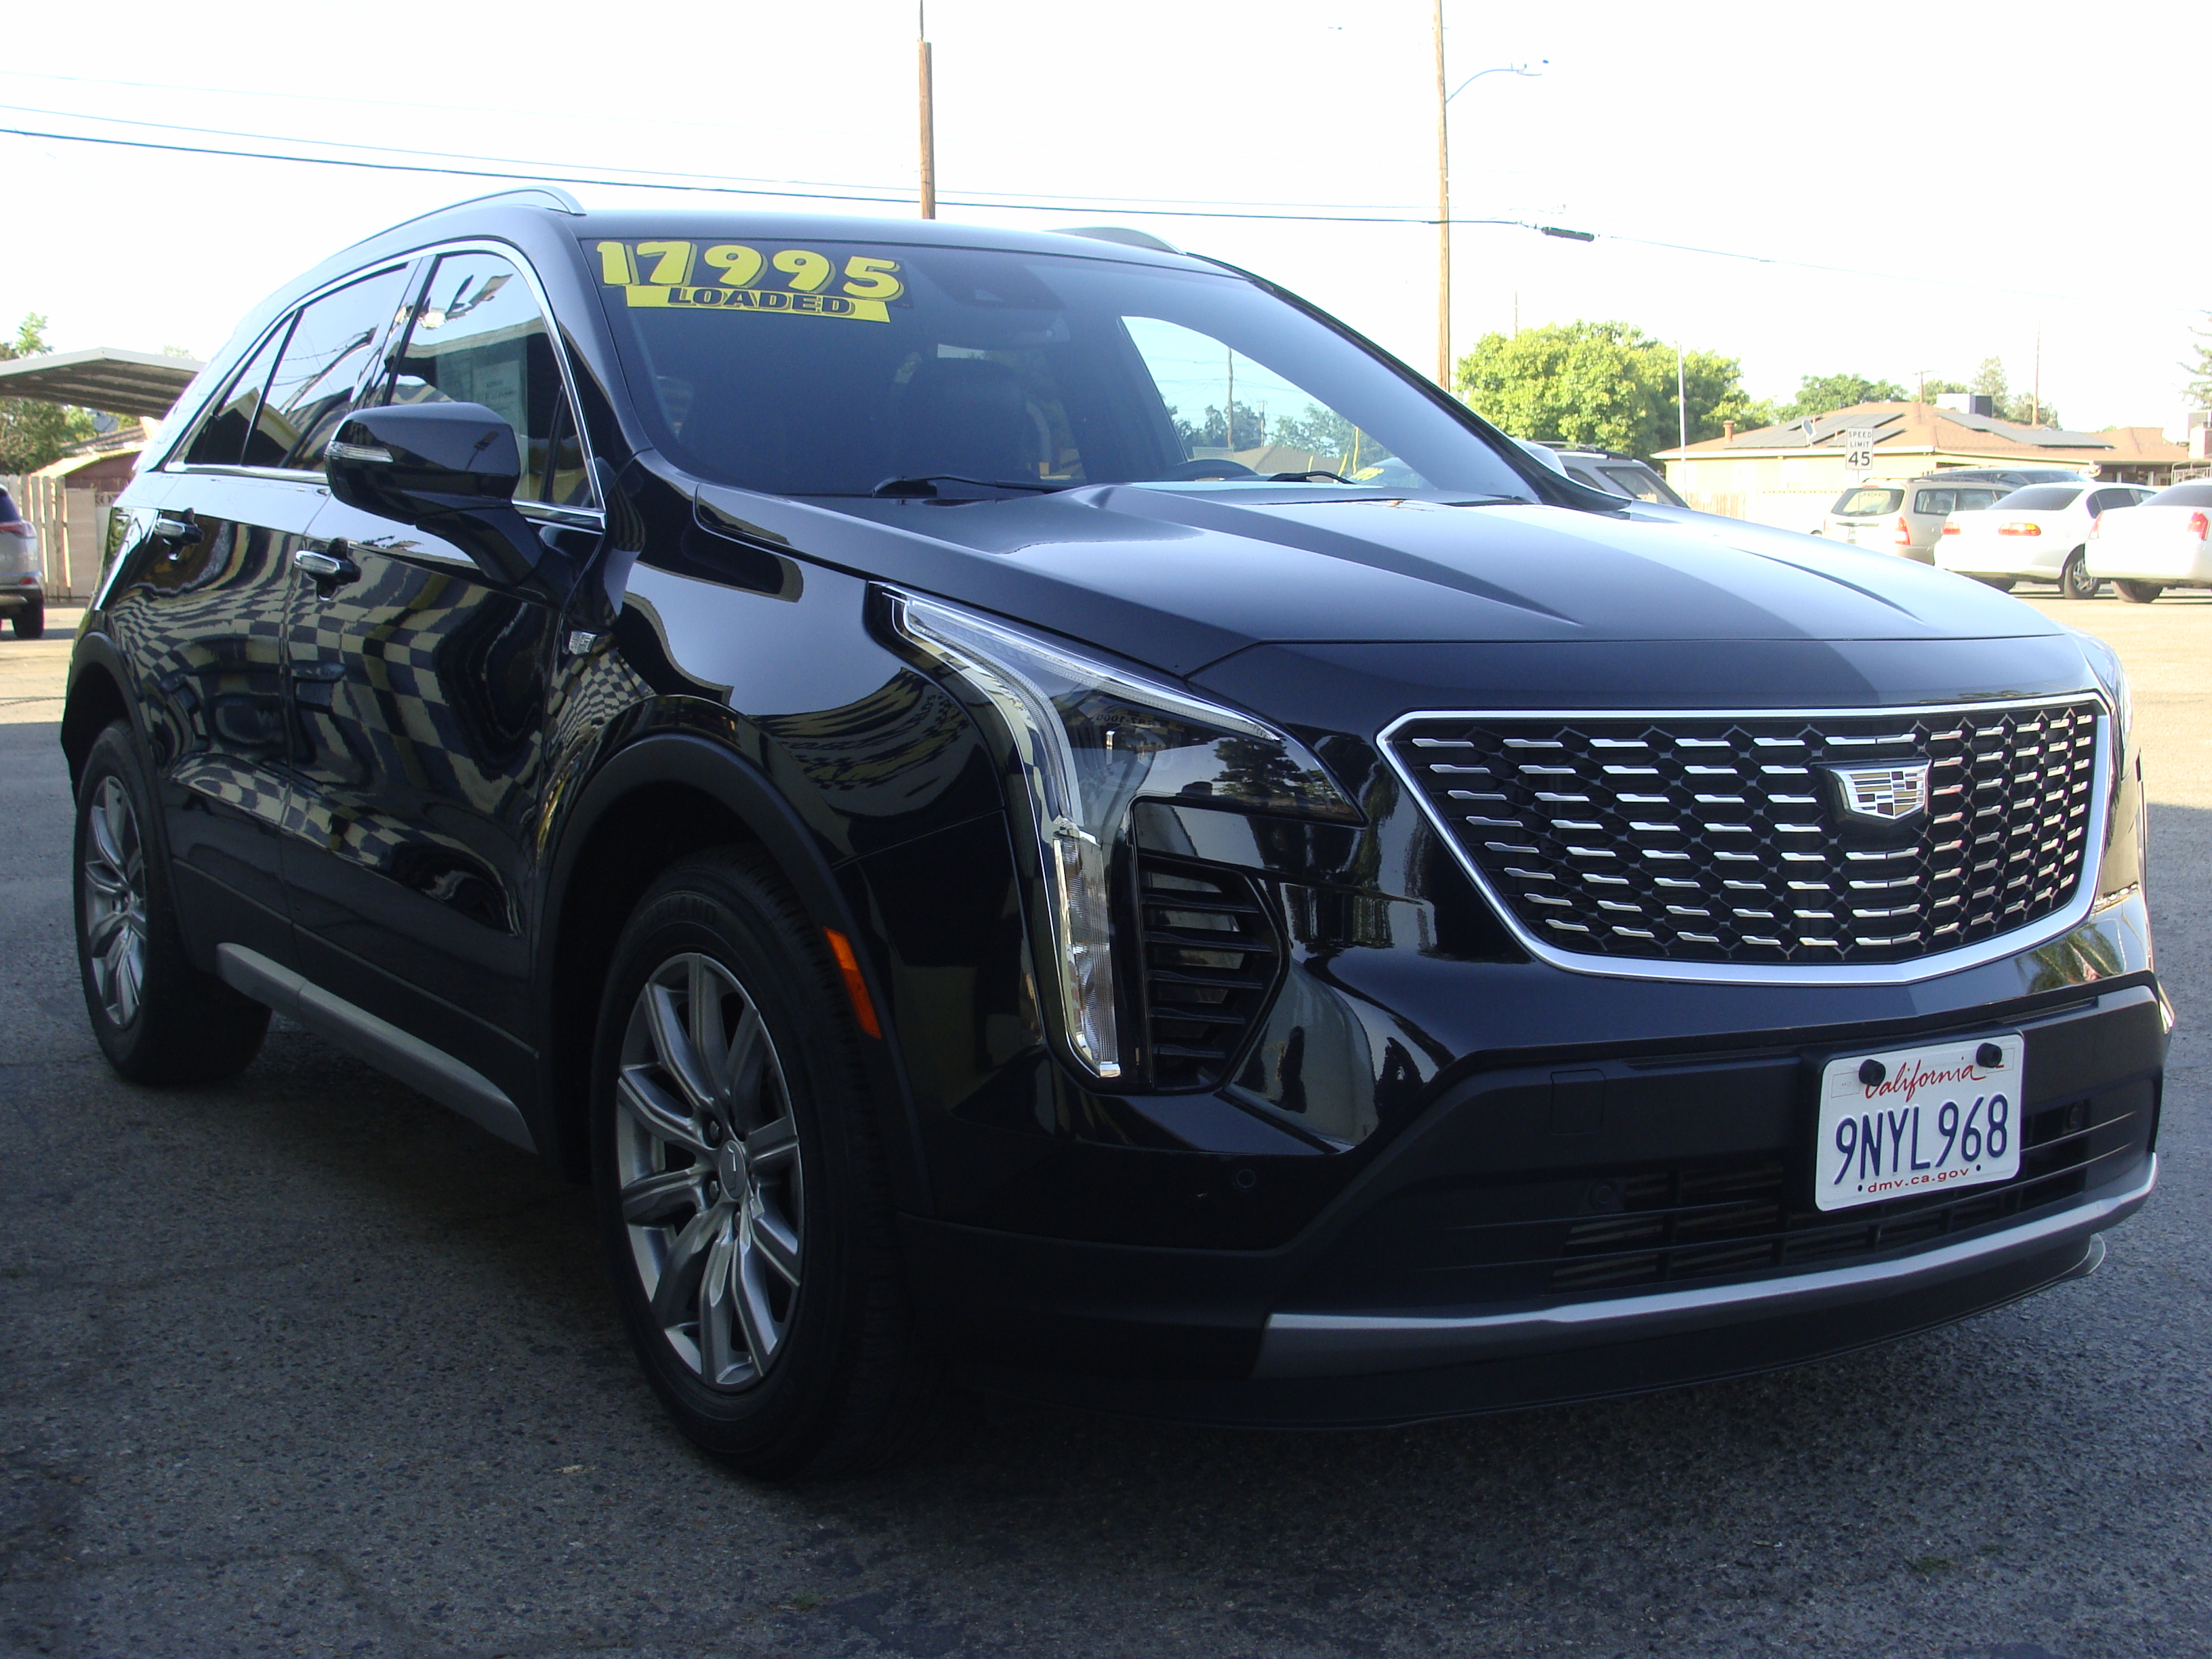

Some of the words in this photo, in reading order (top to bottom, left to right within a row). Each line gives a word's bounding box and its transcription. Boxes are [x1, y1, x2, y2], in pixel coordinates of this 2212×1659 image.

[596, 241, 904, 300] 17995
[668, 287, 855, 316] LOADED
[1848, 451, 1870, 466] 45
[1834, 1093, 2008, 1185] 9NYL968
[1868, 1168, 1969, 1193] dmv.ca.gov
